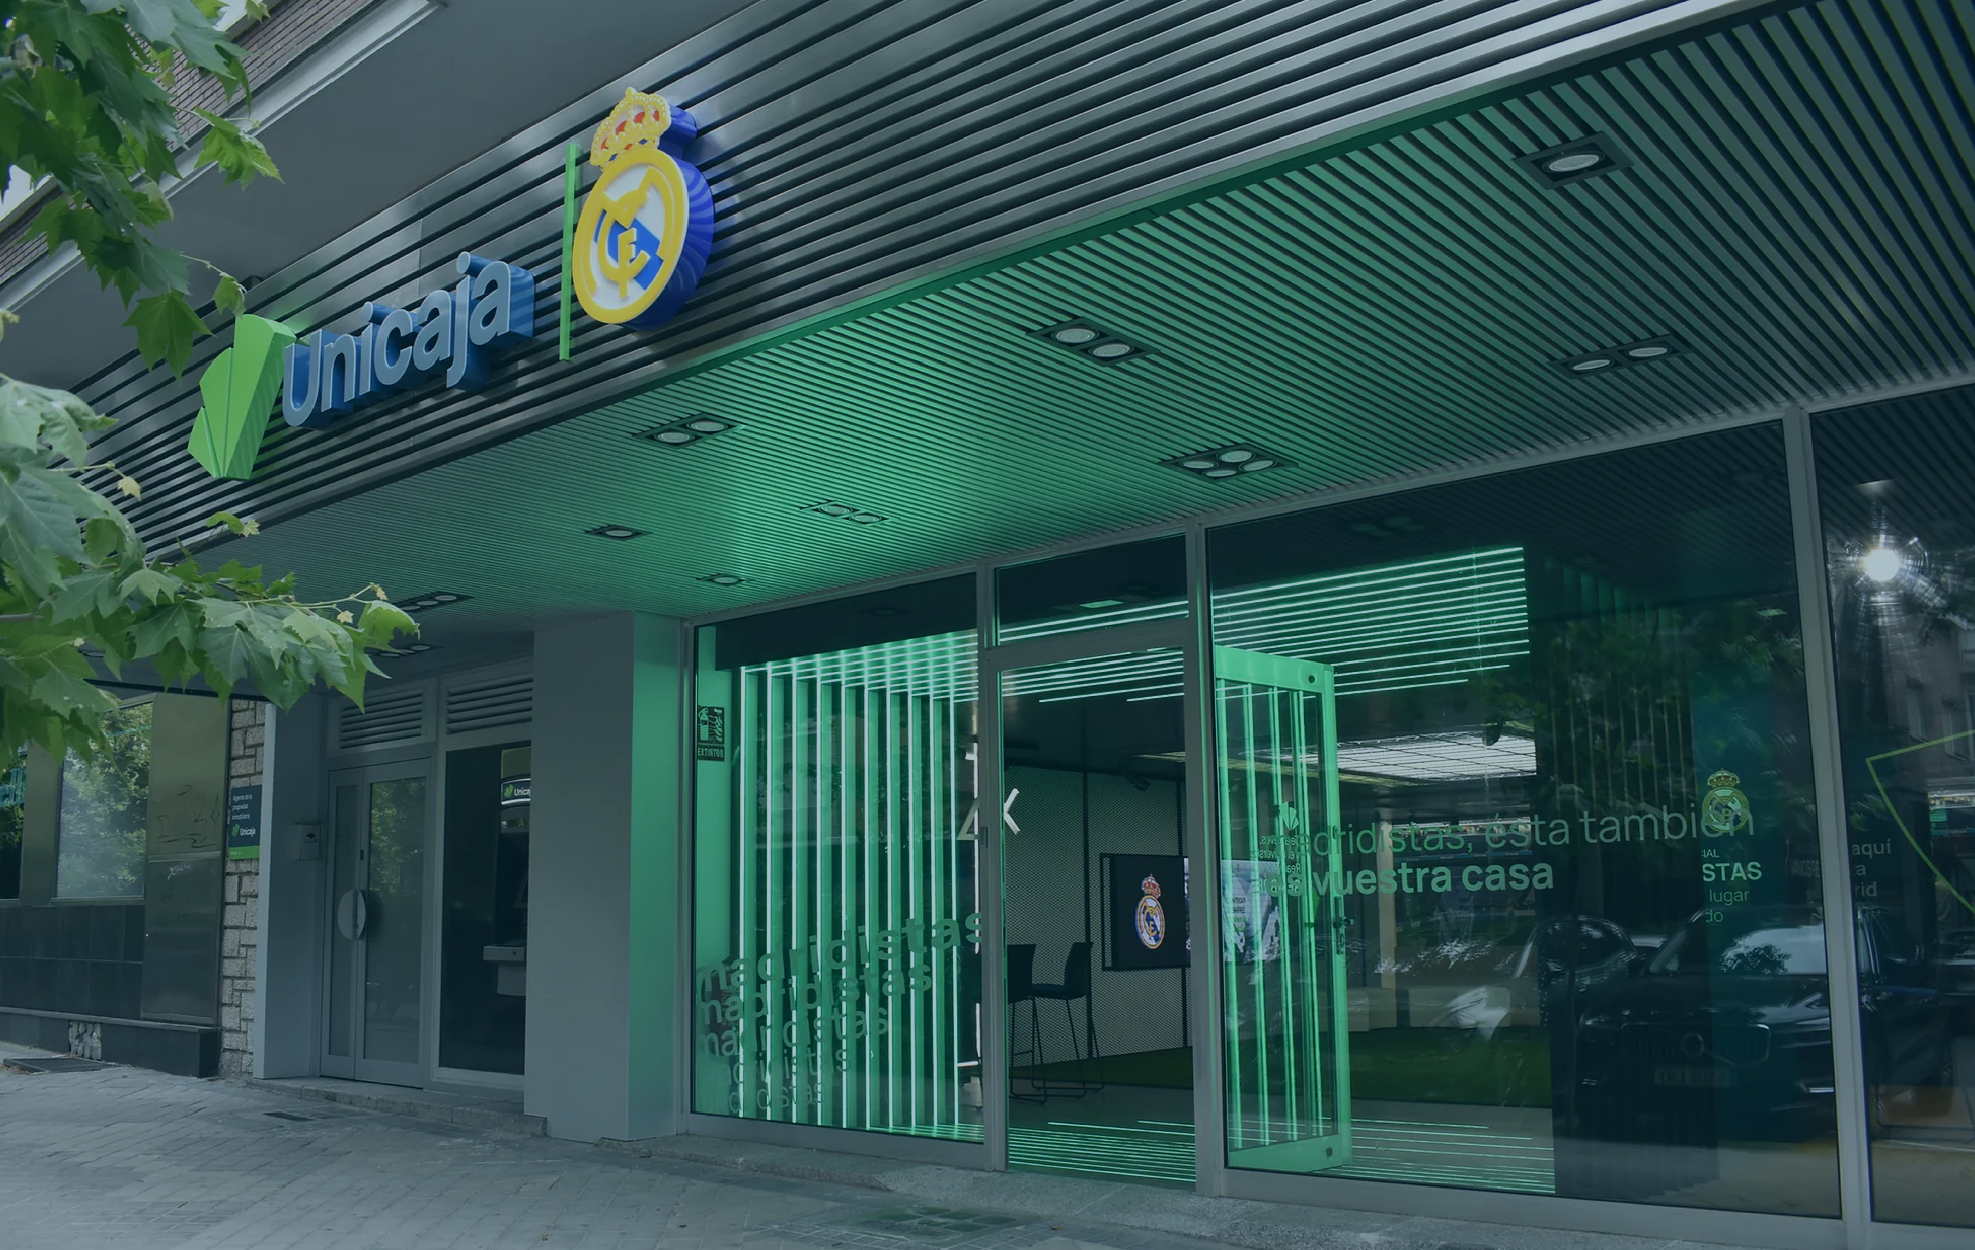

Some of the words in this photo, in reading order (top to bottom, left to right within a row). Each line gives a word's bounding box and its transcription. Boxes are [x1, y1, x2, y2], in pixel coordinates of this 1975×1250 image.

[282, 251, 513, 427] Unicaja
[698, 747, 724, 758] EXTINTOR
[240, 826, 256, 837] Unicaja
[1485, 813, 1570, 848] ésta
[1852, 837, 1891, 860] aquí
[1313, 862, 1452, 897] vuestra
[1462, 862, 1555, 893] casa
[1709, 889, 1751, 906] lugar
[699, 1004, 889, 1058] madrdistas
